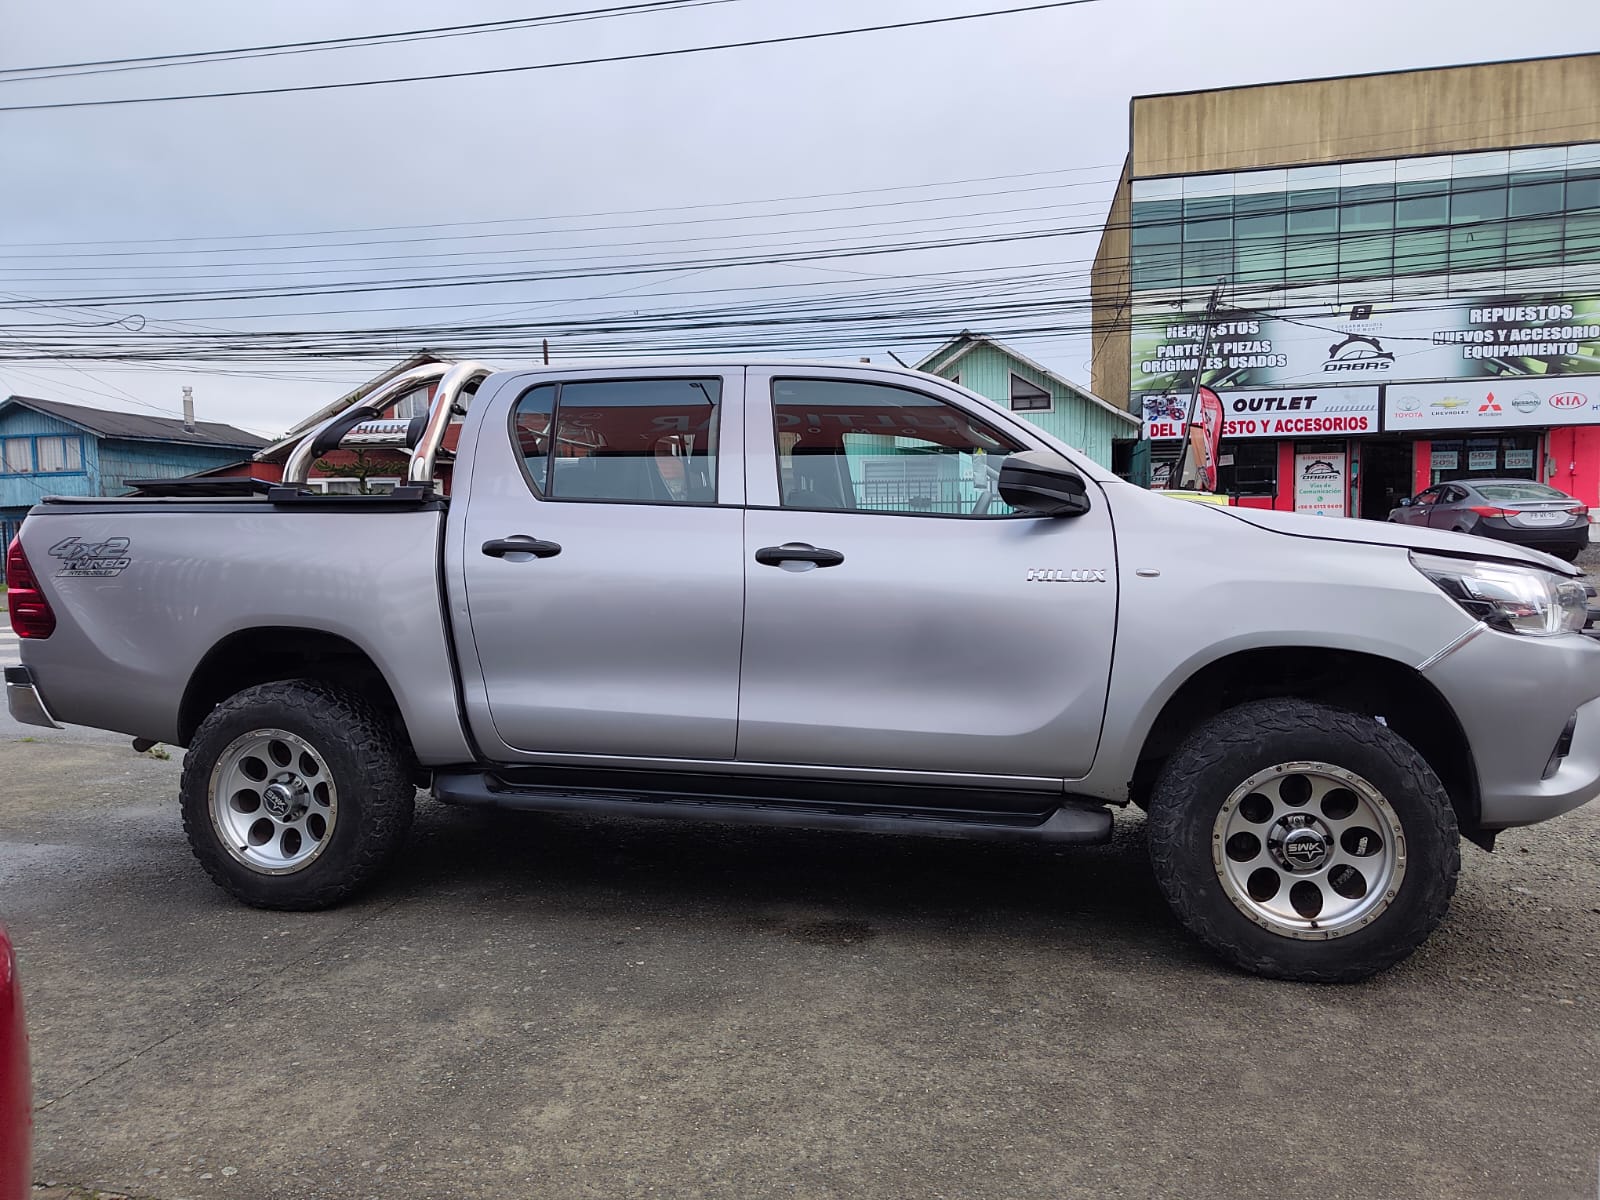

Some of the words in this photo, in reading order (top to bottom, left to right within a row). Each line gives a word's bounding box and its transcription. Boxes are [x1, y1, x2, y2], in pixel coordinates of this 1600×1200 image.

[1469, 304, 1574, 324] REPUESTOS
[1433, 330, 1495, 345] NUEVOS
[1497, 329, 1509, 342] Y
[1211, 342, 1222, 355] Y
[1223, 340, 1271, 355] PIEZAS
[1463, 342, 1579, 359] EQUIPAMIENTO
[1228, 354, 1288, 370] USADOS
[1323, 361, 1392, 372] DABAS
[1232, 396, 1318, 412] OUTLET
[1555, 395, 1581, 406] KIA
[356, 424, 408, 434] HILUX
[1150, 422, 1177, 437] DEL
[1260, 419, 1271, 433] Y
[1274, 416, 1368, 433] ACCESORIOS
[63, 557, 131, 570] TURBO
[1026, 568, 1107, 583] HILUX
